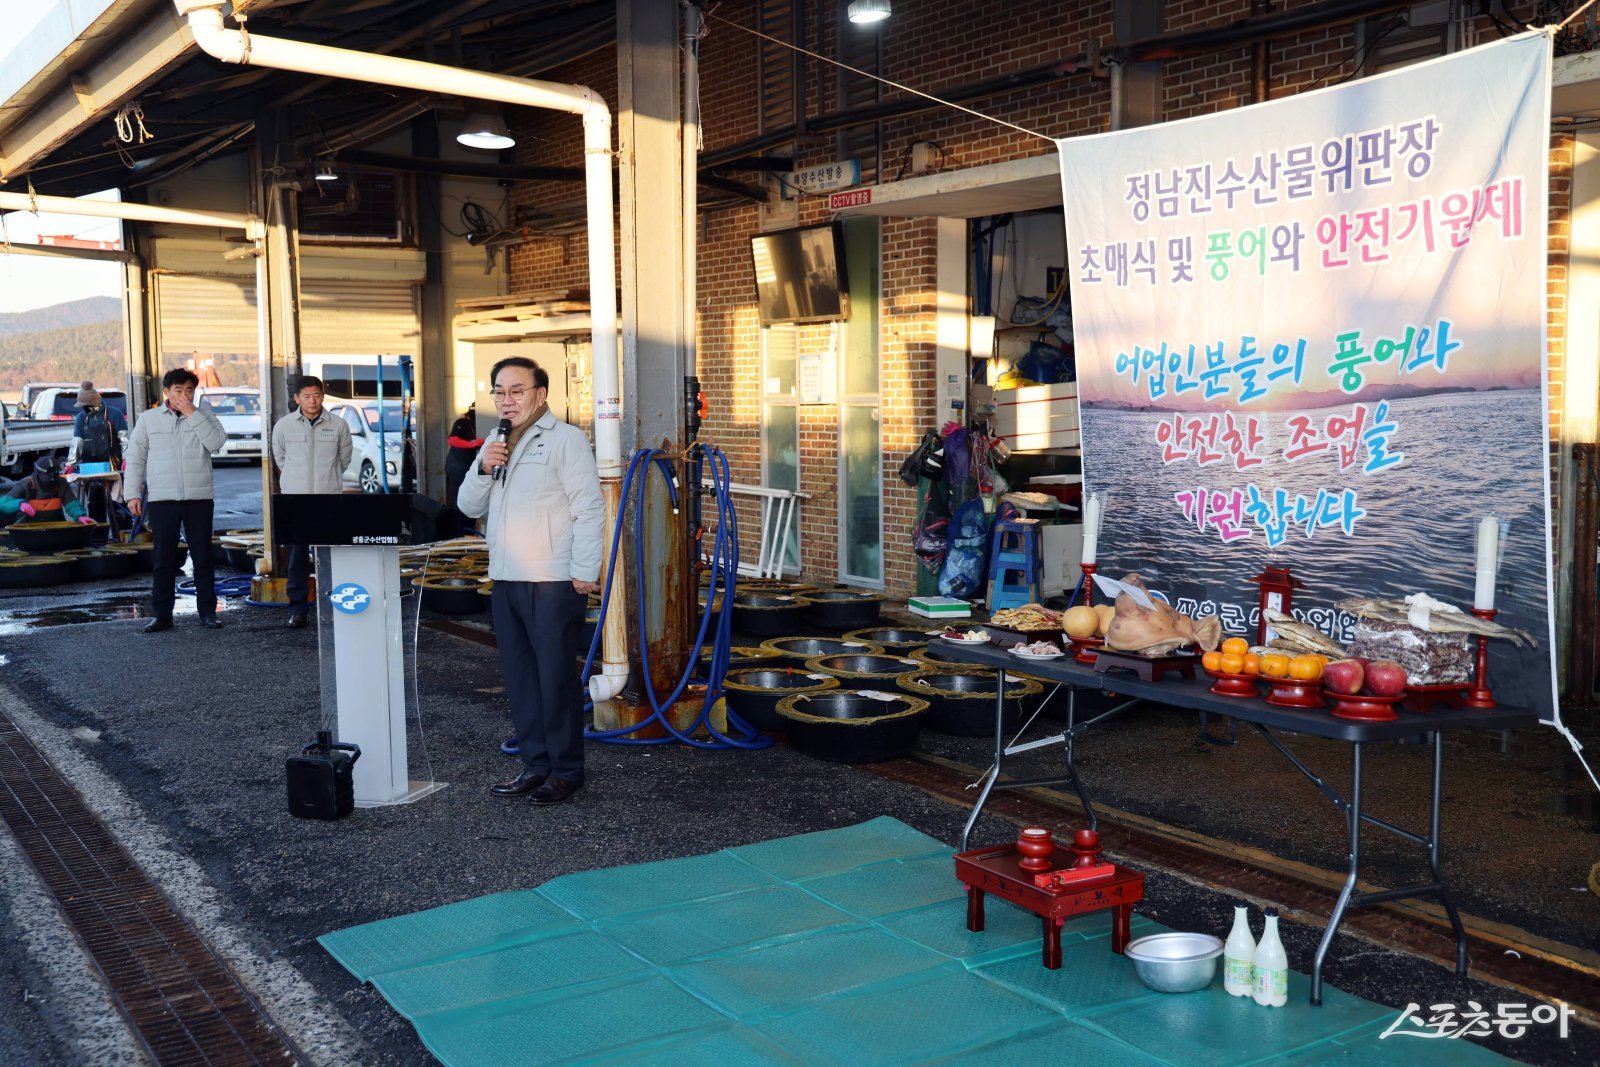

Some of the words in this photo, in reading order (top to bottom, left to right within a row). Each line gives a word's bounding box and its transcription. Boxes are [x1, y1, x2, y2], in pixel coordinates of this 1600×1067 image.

[1125, 117, 1441, 222] 정남진수산물위판장
[1080, 243, 1157, 287] 초매식
[1168, 235, 1194, 284] 및
[1204, 221, 1306, 282] 풍어와
[1316, 177, 1525, 269] 안전기원제
[1115, 335, 1308, 403] 어업인분들의
[1327, 317, 1464, 394] 풍어와
[1156, 411, 1264, 469] 안전한
[1283, 400, 1403, 475] 조업을
[1175, 484, 1367, 548] 기원합니다
